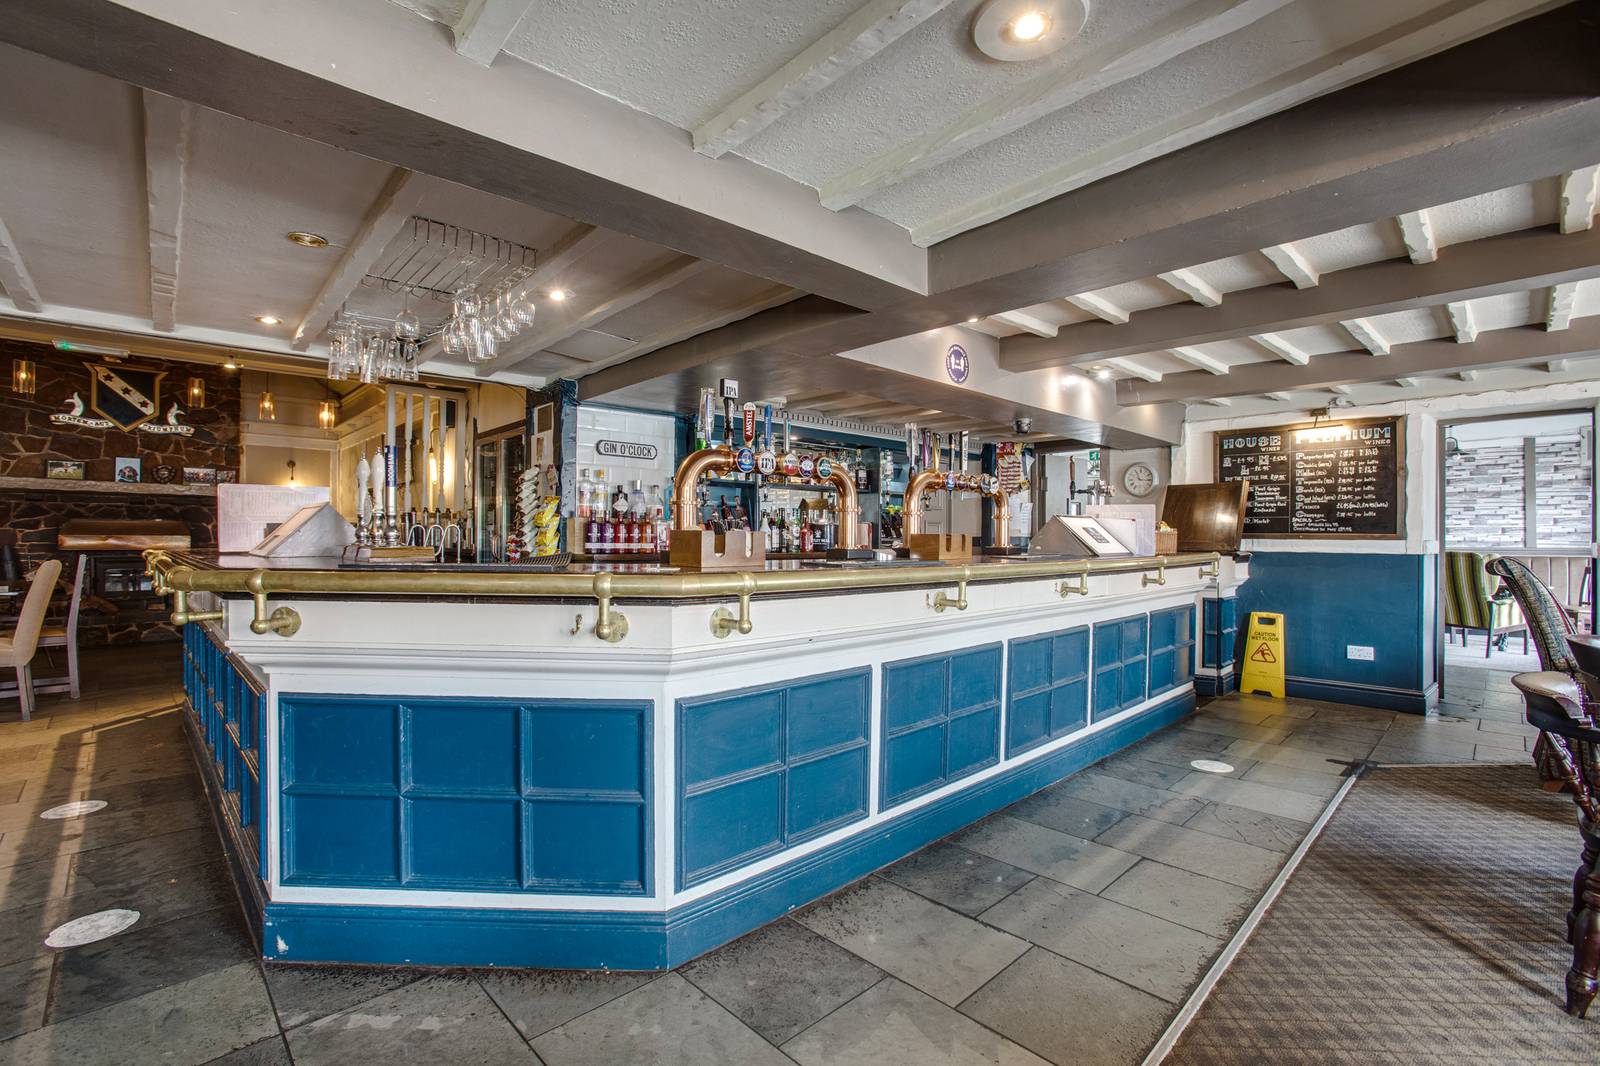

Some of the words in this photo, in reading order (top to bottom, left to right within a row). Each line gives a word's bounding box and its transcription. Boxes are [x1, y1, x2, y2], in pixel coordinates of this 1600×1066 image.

[726, 386, 737, 396] IPA
[745, 411, 753, 436] AMSTEL
[1223, 435, 1281, 449] HOUSE
[1296, 427, 1391, 444] MIUM
[603, 442, 617, 453] GIN
[620, 444, 652, 457] O'CLOCK
[761, 458, 774, 469] IPA
